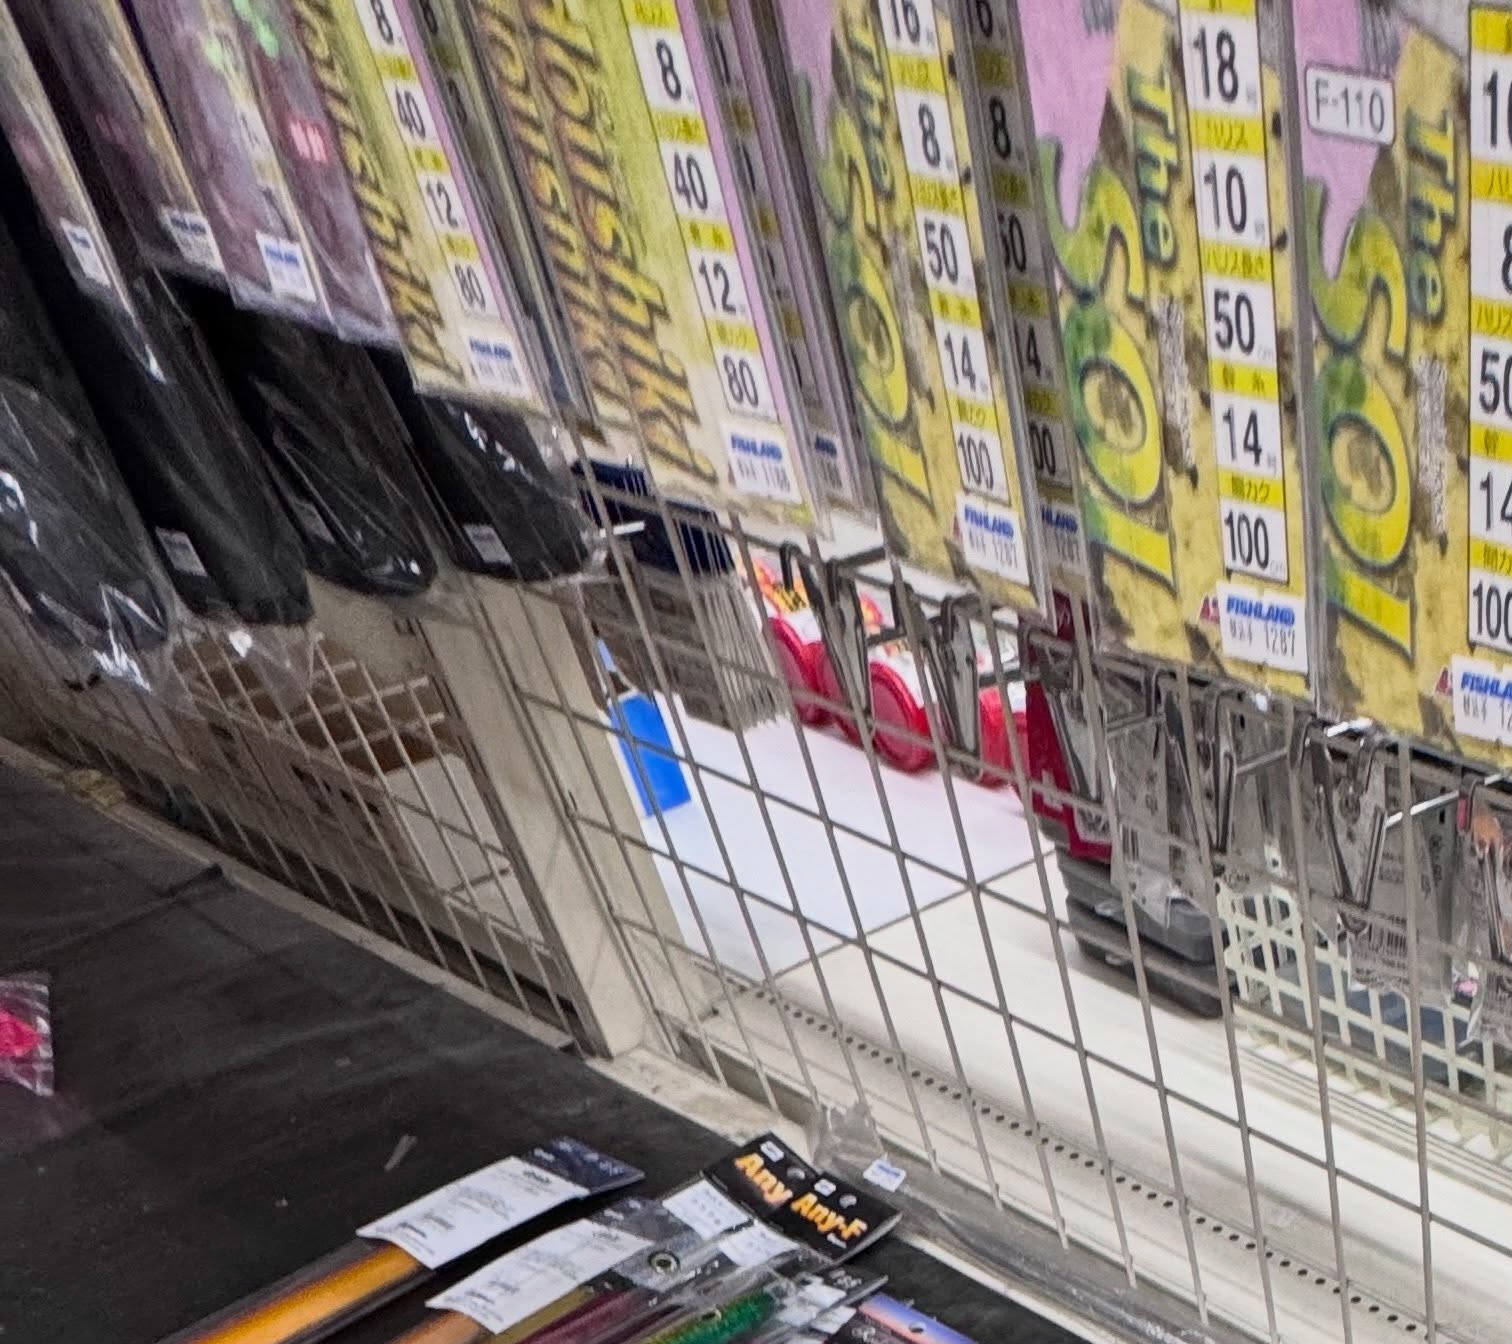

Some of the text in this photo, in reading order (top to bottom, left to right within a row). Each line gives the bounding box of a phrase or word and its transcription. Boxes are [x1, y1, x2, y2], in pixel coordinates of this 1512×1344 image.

[654, 37, 682, 100] 8
[1192, 27, 1239, 104] 18
[918, 103, 940, 168] 8
[1314, 77, 1385, 134] F-110
[674, 151, 708, 211] 40
[1203, 162, 1248, 234] 10
[924, 217, 959, 284] 50
[698, 258, 733, 316] 12
[1214, 289, 1256, 354] 50
[722, 355, 759, 410] 80
[943, 331, 979, 393] 14
[958, 430, 995, 490] 100
[1223, 407, 1263, 466] 14
[1224, 510, 1270, 571] 100
[1226, 594, 1296, 627] FISHLAND
[734, 1152, 794, 1206] Any
[790, 1191, 868, 1241] Any-F
